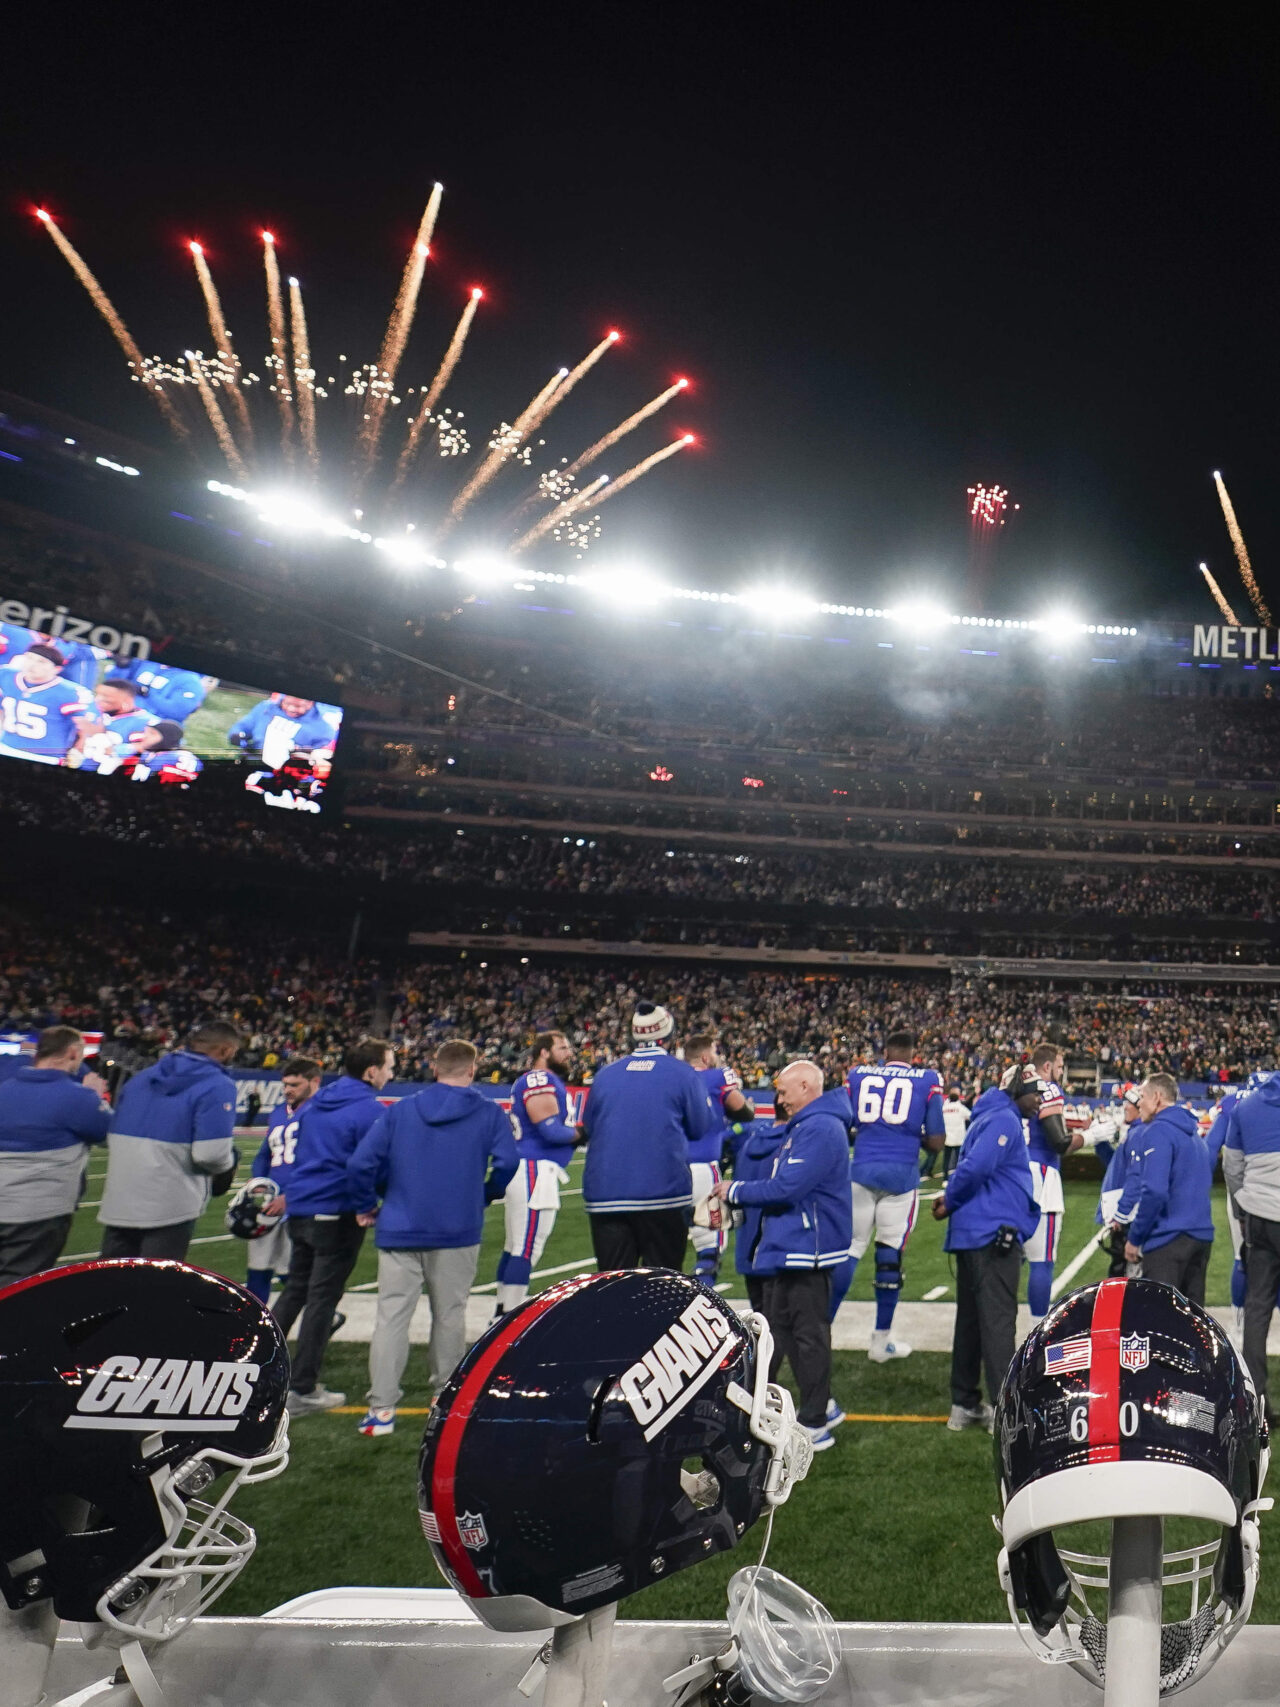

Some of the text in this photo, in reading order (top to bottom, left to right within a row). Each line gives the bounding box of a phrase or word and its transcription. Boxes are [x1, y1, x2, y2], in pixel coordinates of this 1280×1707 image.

[0, 597, 151, 660] erizon
[527, 1071, 549, 1088] 65
[858, 1075, 913, 1125] 60
[620, 1295, 731, 1426] GIANTS
[1123, 1351, 1145, 1365] NFL
[76, 1355, 260, 1416] GIANTS
[462, 1529, 485, 1548] NFL
